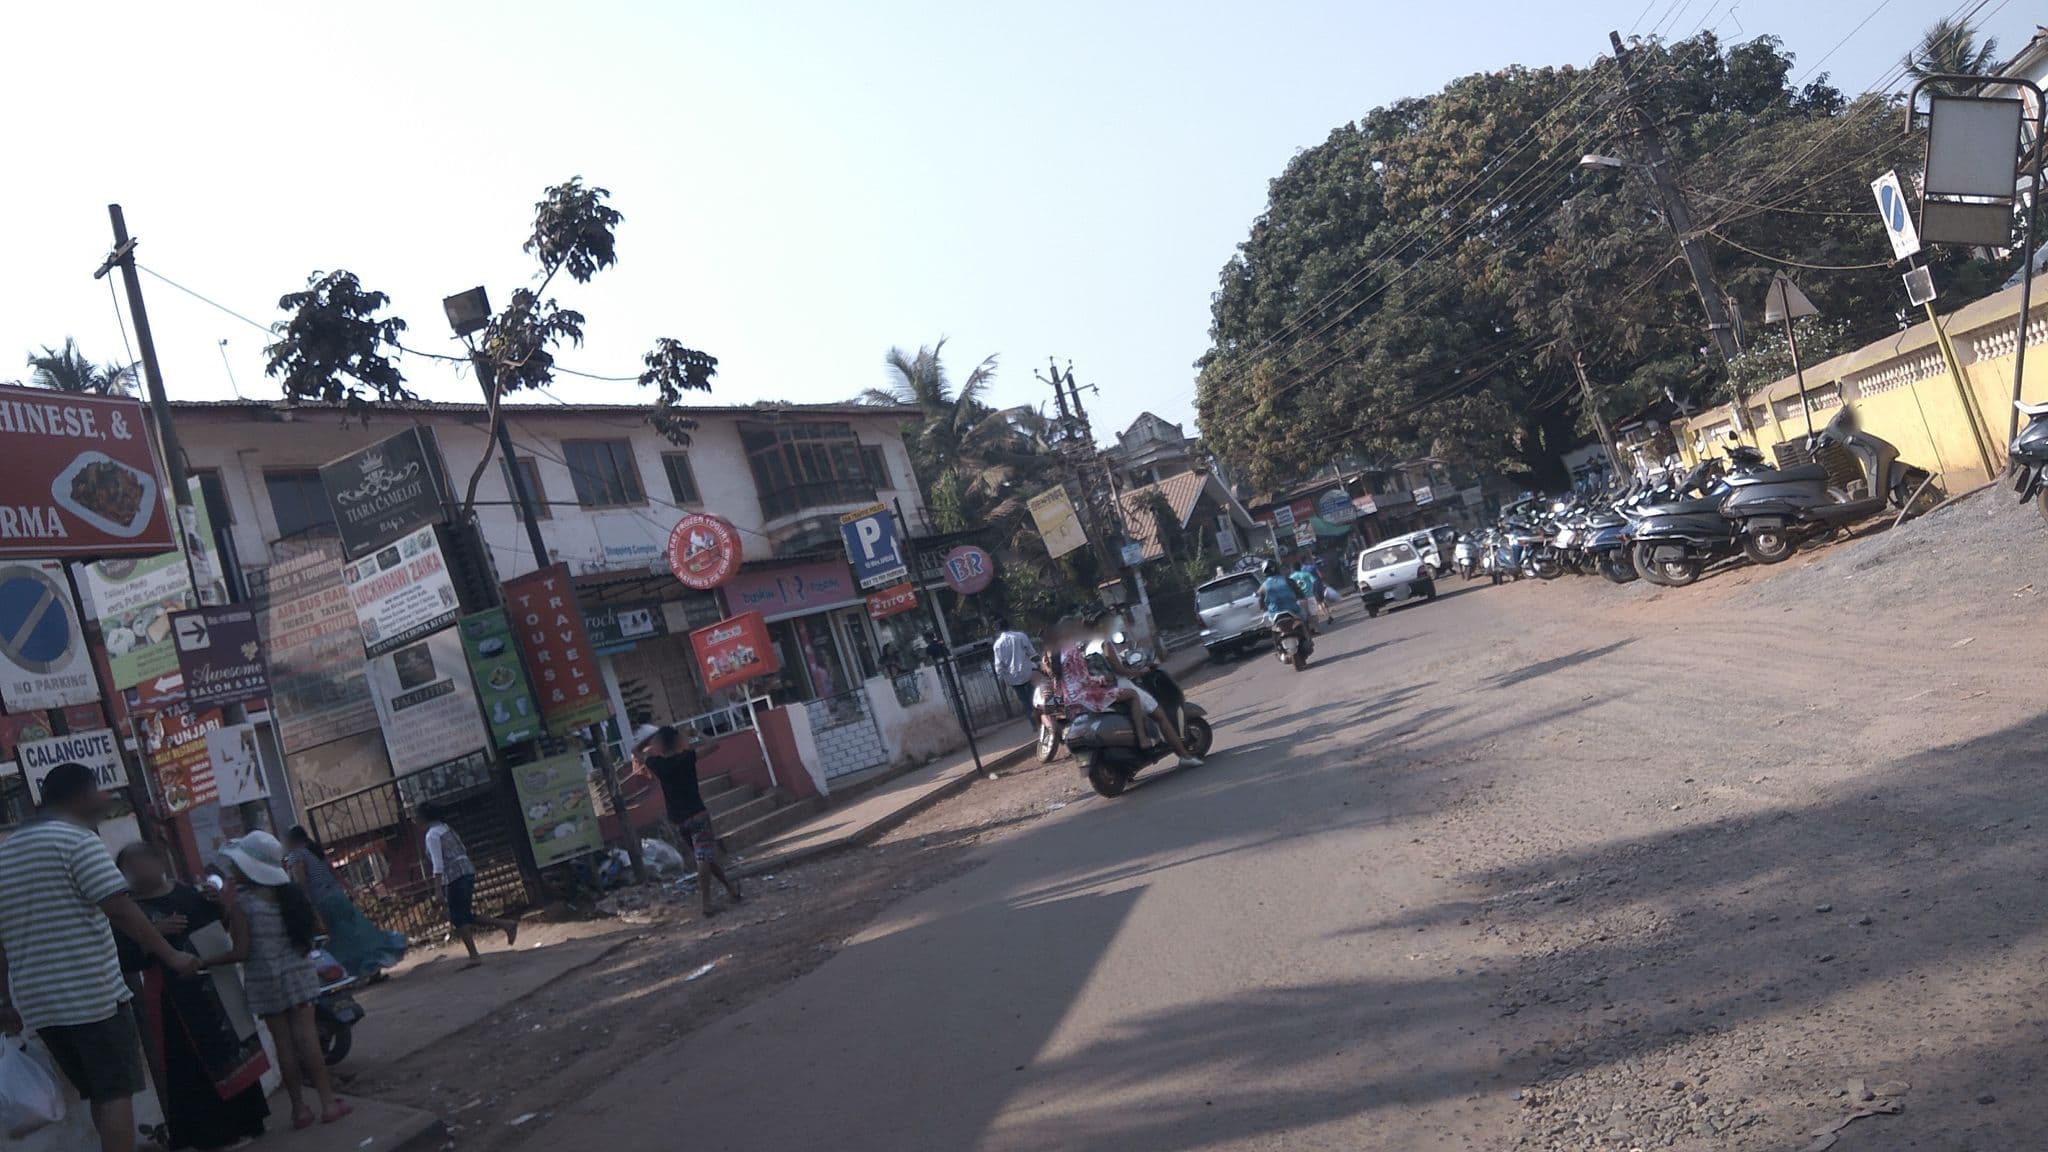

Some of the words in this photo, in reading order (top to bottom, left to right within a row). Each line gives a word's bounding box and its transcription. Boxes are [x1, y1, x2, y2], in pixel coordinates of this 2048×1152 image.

[111, 410, 132, 440] &
[346, 500, 375, 523] TIARA
[376, 482, 423, 510] CAMELOT
[0, 506, 68, 538] RMA
[856, 517, 880, 560] P
[947, 551, 984, 583] BR
[299, 596, 322, 612] BUS
[324, 586, 350, 604] RAIL
[882, 591, 915, 609] TITO'S
[520, 595, 556, 681] TOURS
[552, 689, 565, 702] &
[544, 579, 590, 696] TRAVELS
[12, 680, 32, 694] NO
[36, 674, 88, 691] PARKING
[190, 681, 231, 697] SALON
[246, 676, 265, 687] SPA
[192, 663, 263, 686] Awesome
[26, 735, 112, 767] CALANGUTE
